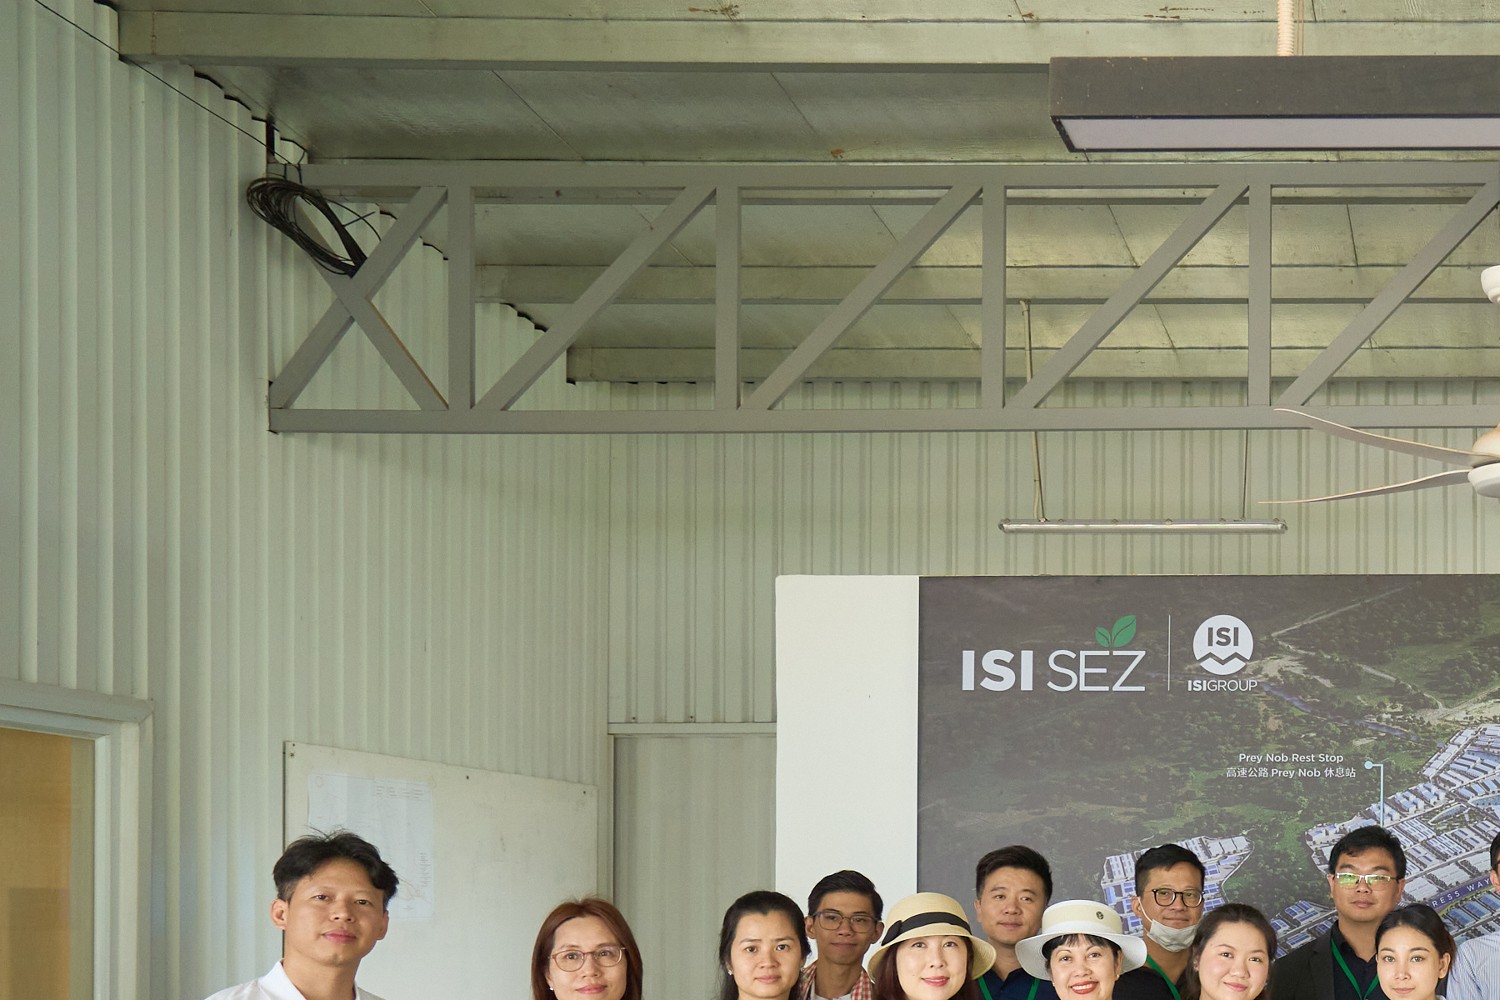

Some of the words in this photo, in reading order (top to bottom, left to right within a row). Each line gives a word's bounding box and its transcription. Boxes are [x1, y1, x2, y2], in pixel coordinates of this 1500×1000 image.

[1207, 627, 1240, 647] ISI
[961, 649, 1034, 692] ISI
[1046, 649, 1147, 692] SEZ
[1187, 679, 1258, 692] ISIGROUP
[1239, 753, 1263, 764] Prey
[1266, 753, 1288, 762] Nob
[1291, 753, 1315, 762] Rest
[1318, 753, 1344, 764] Stop
[1226, 767, 1269, 778] 高速公路
[1271, 768, 1296, 779] Prey
[1298, 768, 1321, 778] Nob
[1324, 767, 1356, 778] 休息站
[1428, 891, 1460, 907] RESS
[1466, 878, 1490, 892] WAY
